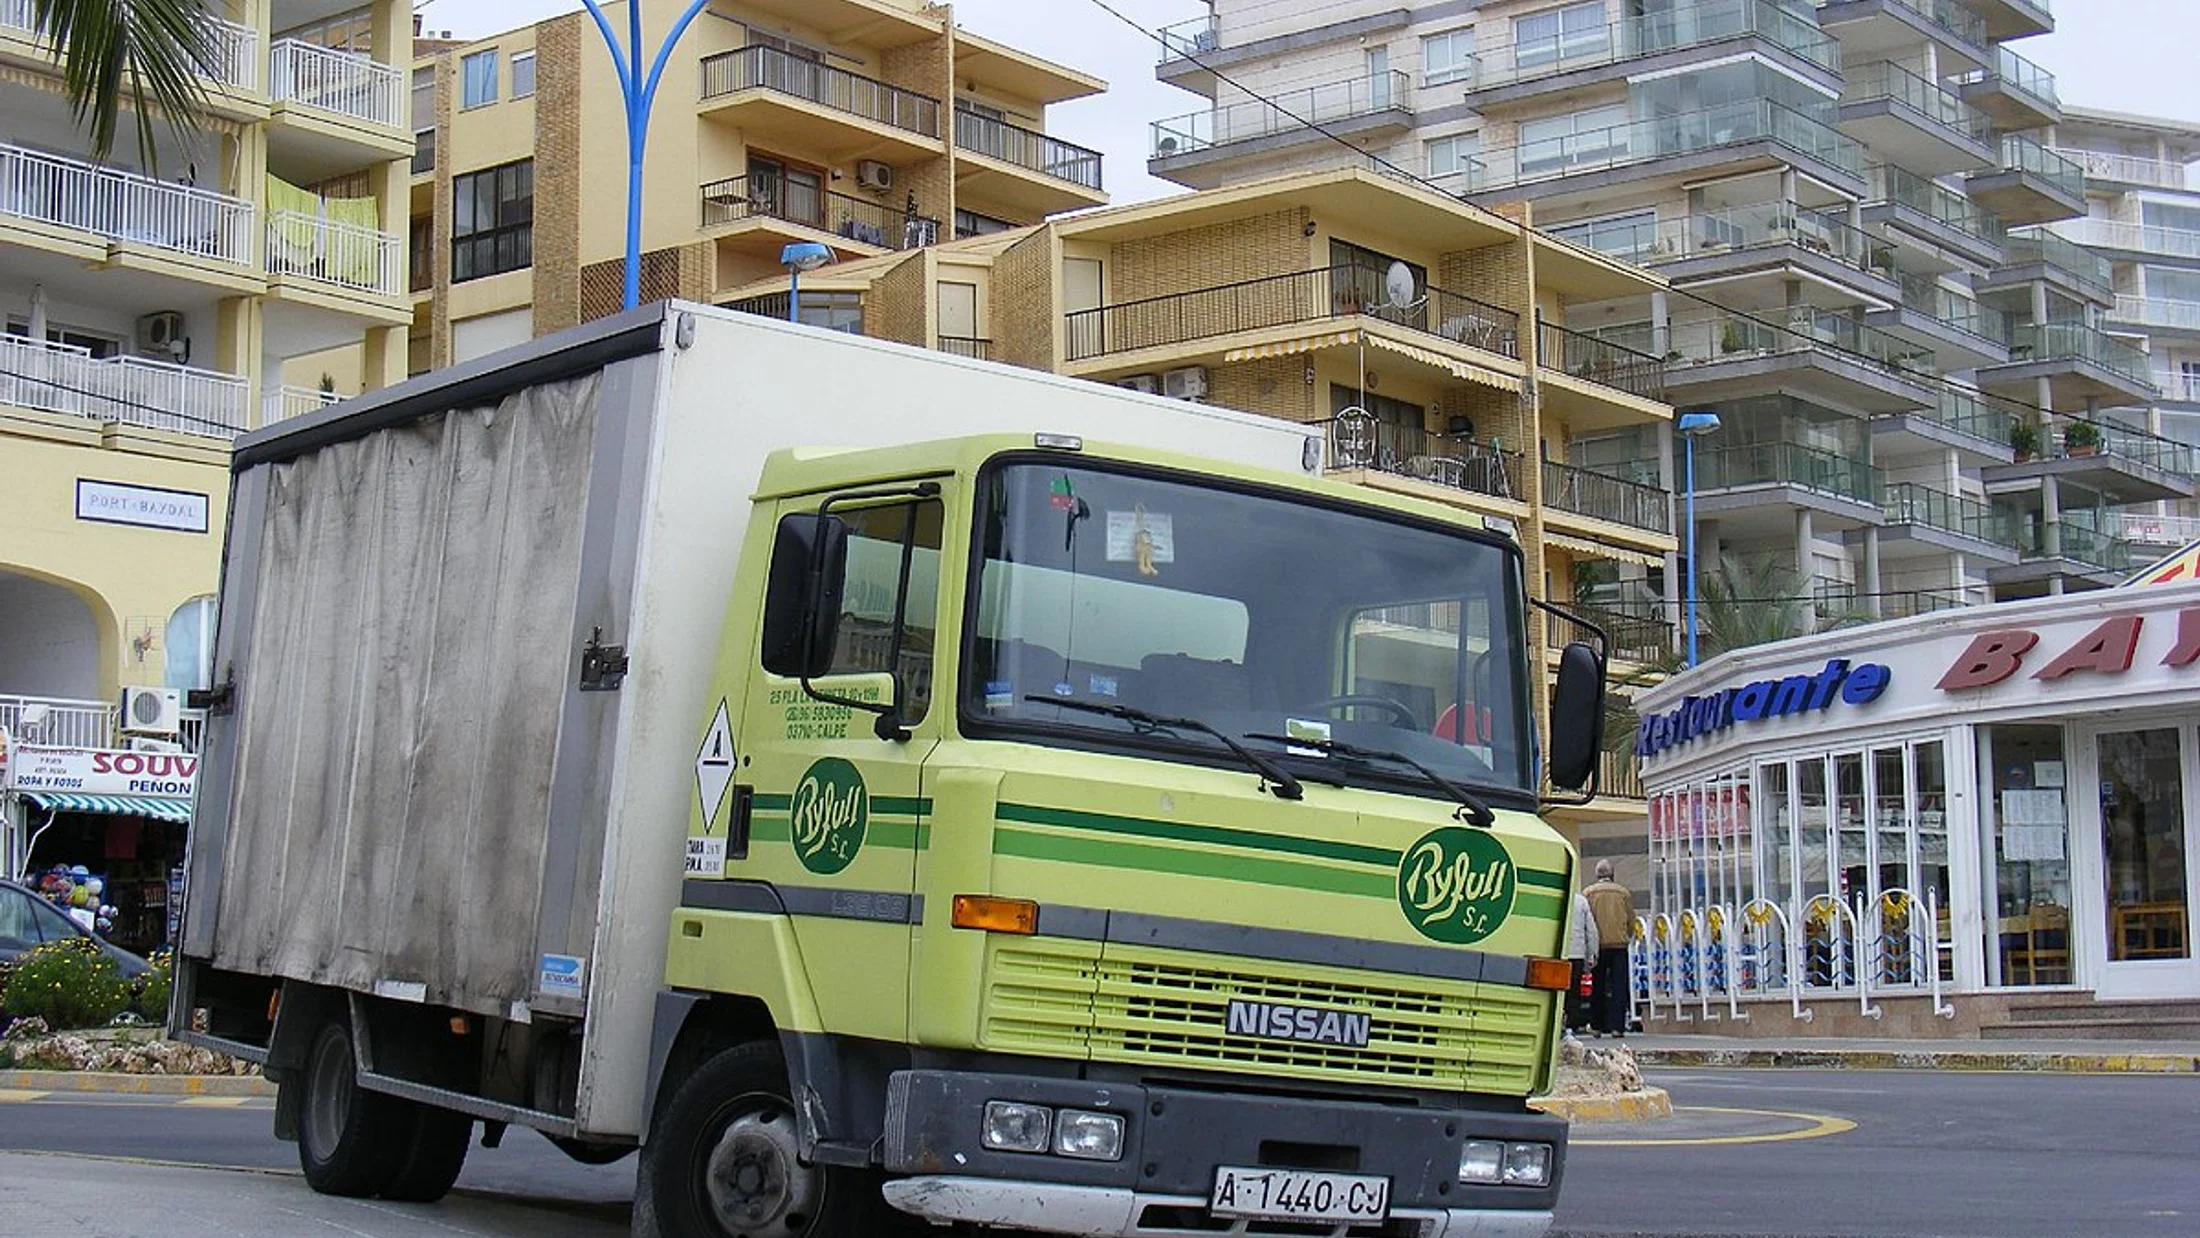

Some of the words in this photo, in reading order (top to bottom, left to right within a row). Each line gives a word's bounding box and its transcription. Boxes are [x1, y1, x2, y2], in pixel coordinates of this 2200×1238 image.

[1636, 659, 1892, 757] Restaurante
[713, 730, 721, 757] A
[17, 775, 42, 786] ROPA
[46, 776, 52, 787] Y
[54, 777, 83, 788] FOTOS
[1228, 1001, 1370, 1045] NISSAN
